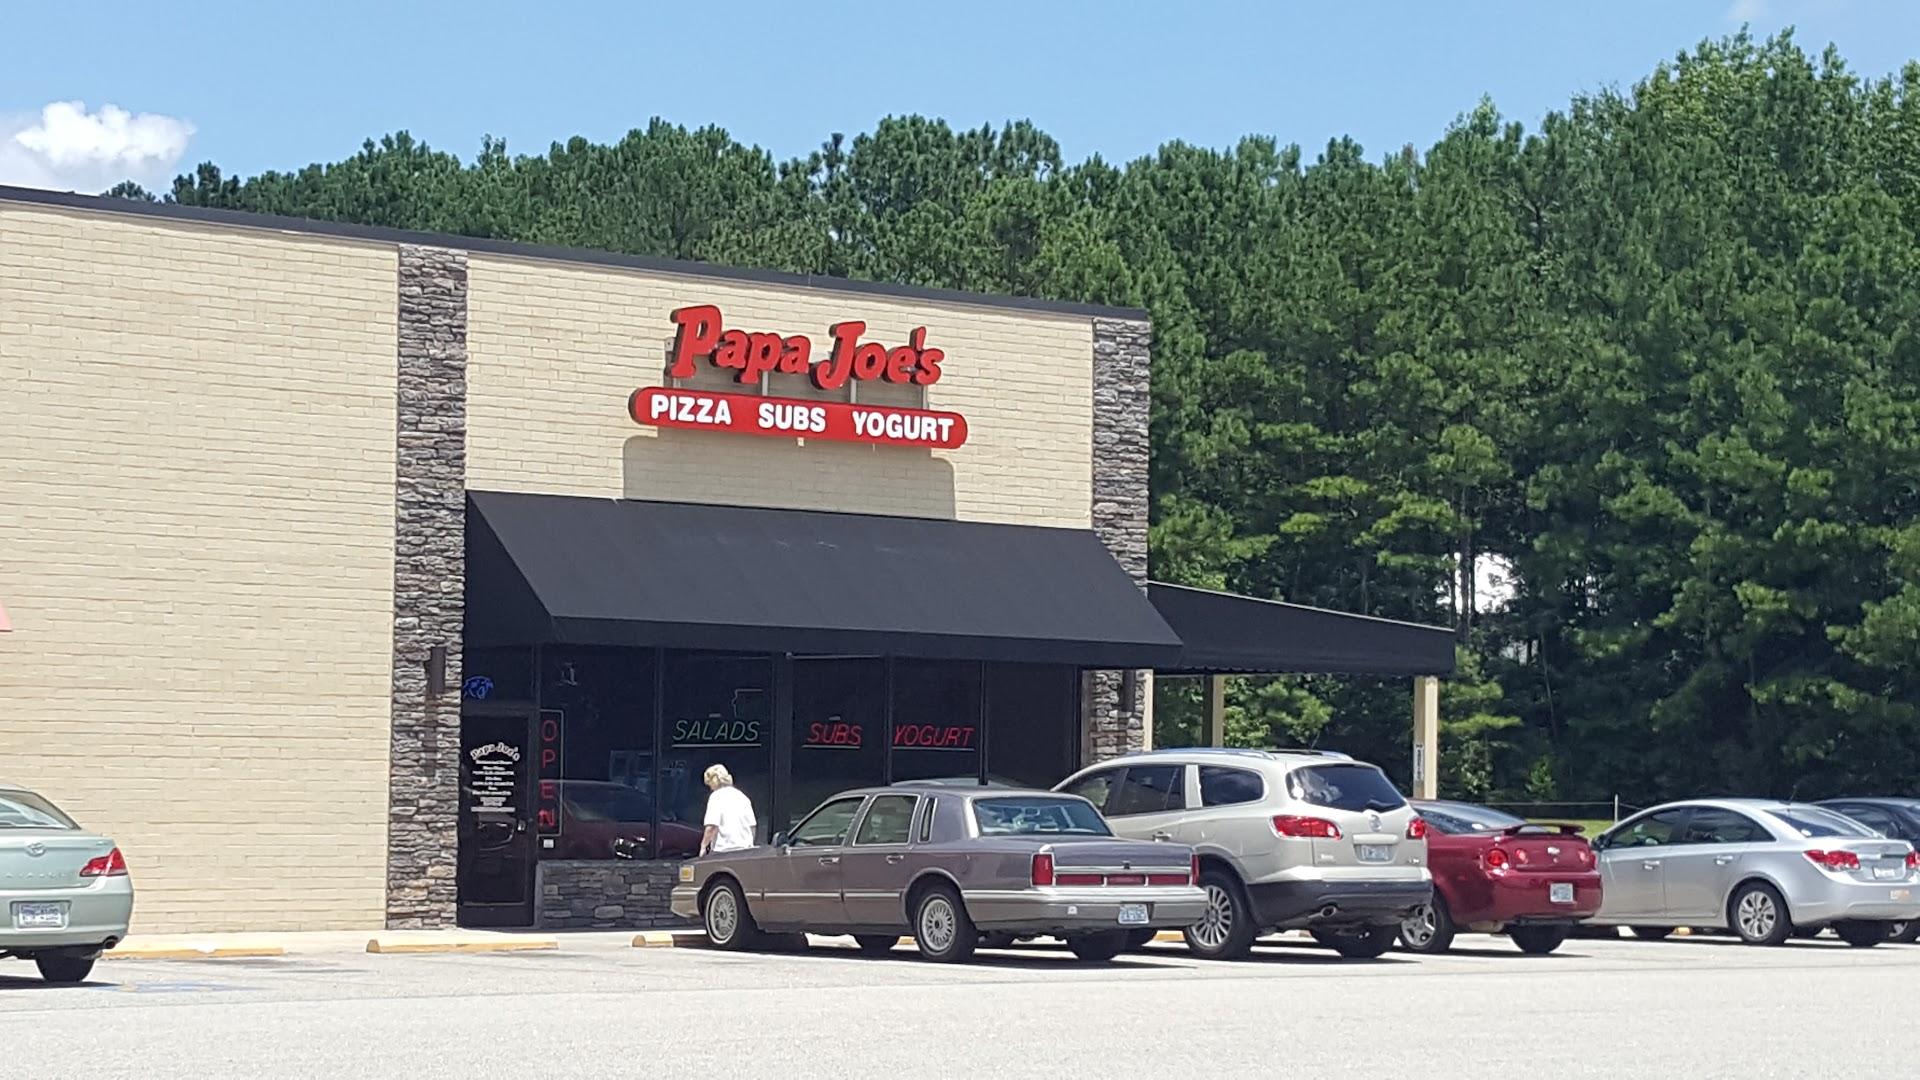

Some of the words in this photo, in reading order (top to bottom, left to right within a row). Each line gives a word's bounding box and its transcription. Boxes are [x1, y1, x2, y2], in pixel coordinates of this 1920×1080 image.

[671, 304, 811, 384] Papa
[811, 319, 945, 390] Joe's
[650, 394, 732, 426] PIZZA
[758, 402, 826, 433] SUBS
[852, 411, 955, 443] YOGURT
[672, 720, 761, 742] SALADS
[807, 722, 863, 746] SUBS
[892, 724, 975, 747] YOGURT
[538, 720, 558, 827] OPEN
